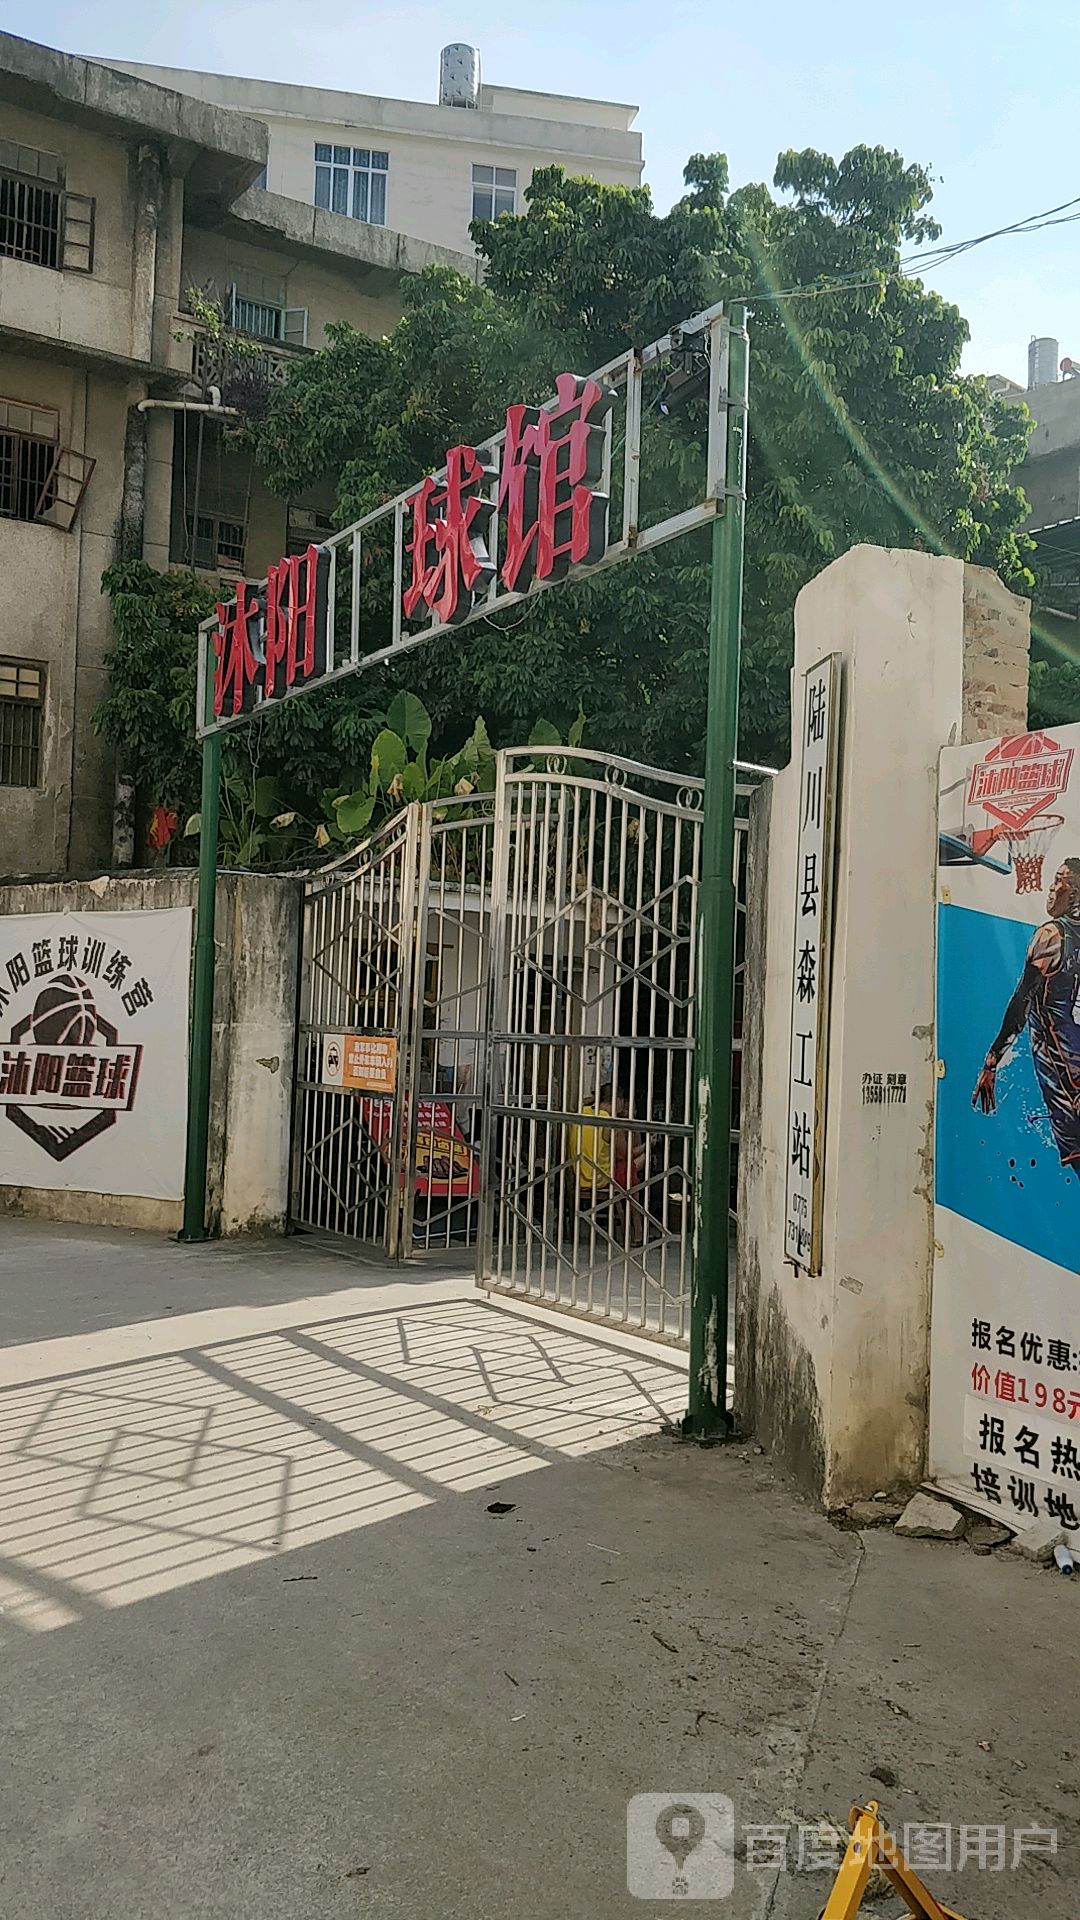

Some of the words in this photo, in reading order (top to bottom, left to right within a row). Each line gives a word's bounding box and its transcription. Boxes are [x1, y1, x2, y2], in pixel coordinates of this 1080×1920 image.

[791, 678, 827, 1179] 陆川县森工站
[971, 1317, 1080, 1372] 报名优惠:
[978, 1413, 1080, 1482] 报名热
[970, 1462, 1080, 1531] 培训地
